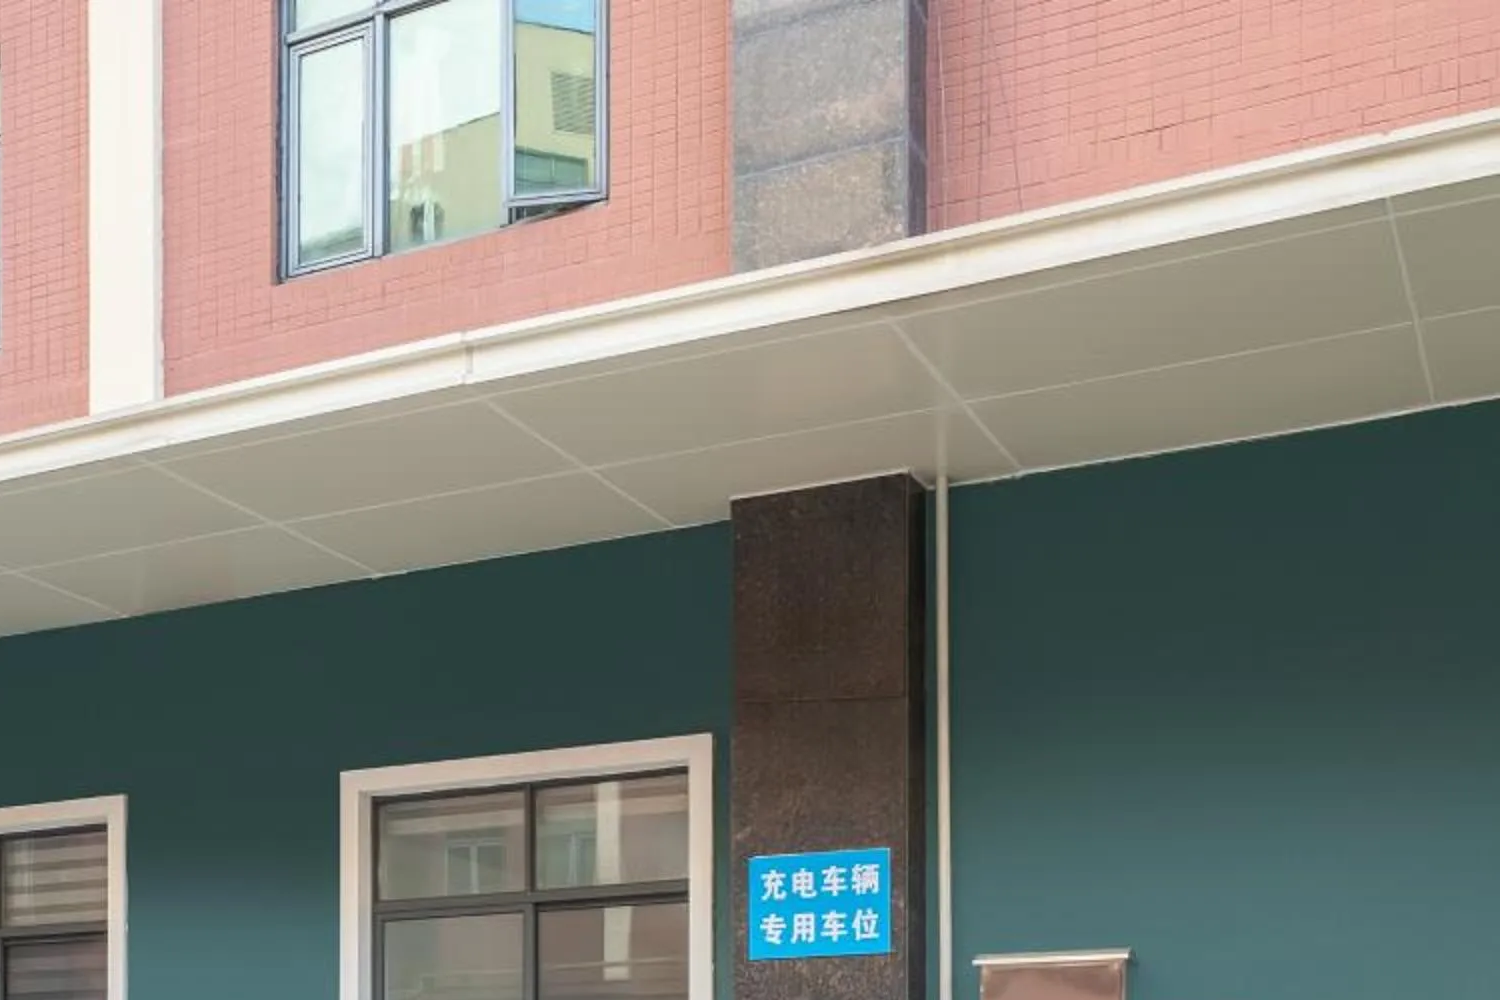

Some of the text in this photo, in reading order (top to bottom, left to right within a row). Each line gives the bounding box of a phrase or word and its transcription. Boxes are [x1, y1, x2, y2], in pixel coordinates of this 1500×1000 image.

[760, 863, 880, 901] 充电车辆
[759, 907, 880, 945] 专用车位
